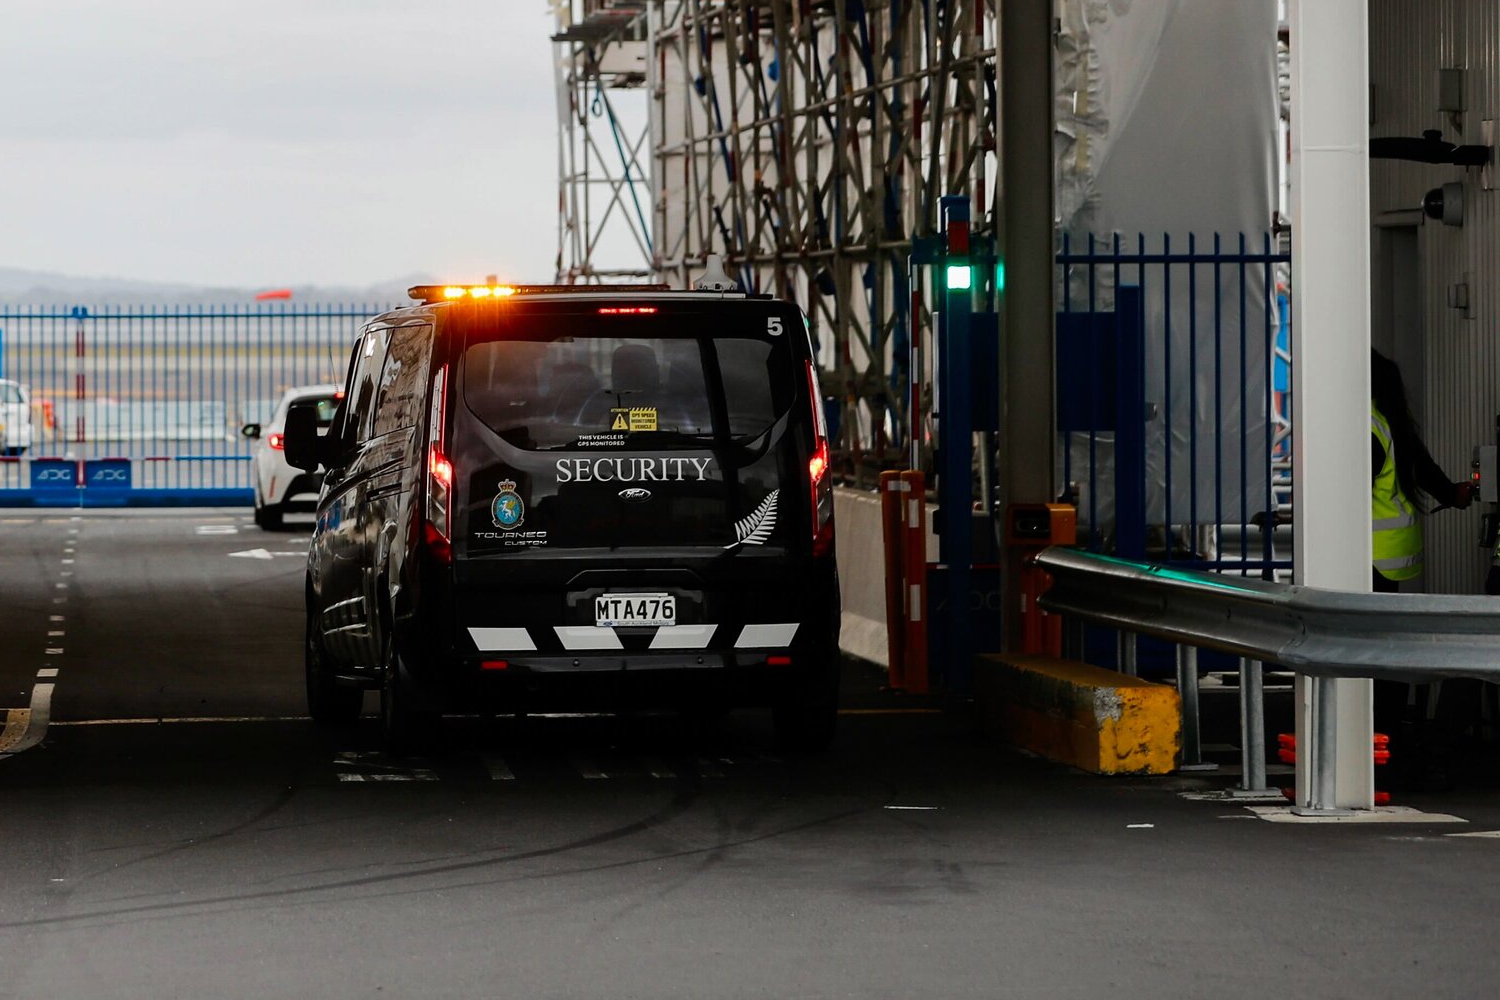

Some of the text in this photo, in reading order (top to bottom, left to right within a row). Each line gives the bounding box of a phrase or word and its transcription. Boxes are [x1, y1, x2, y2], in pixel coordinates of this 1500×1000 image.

[767, 316, 783, 336] 5
[556, 457, 713, 482] SECURITY
[597, 600, 674, 620] MTA476
